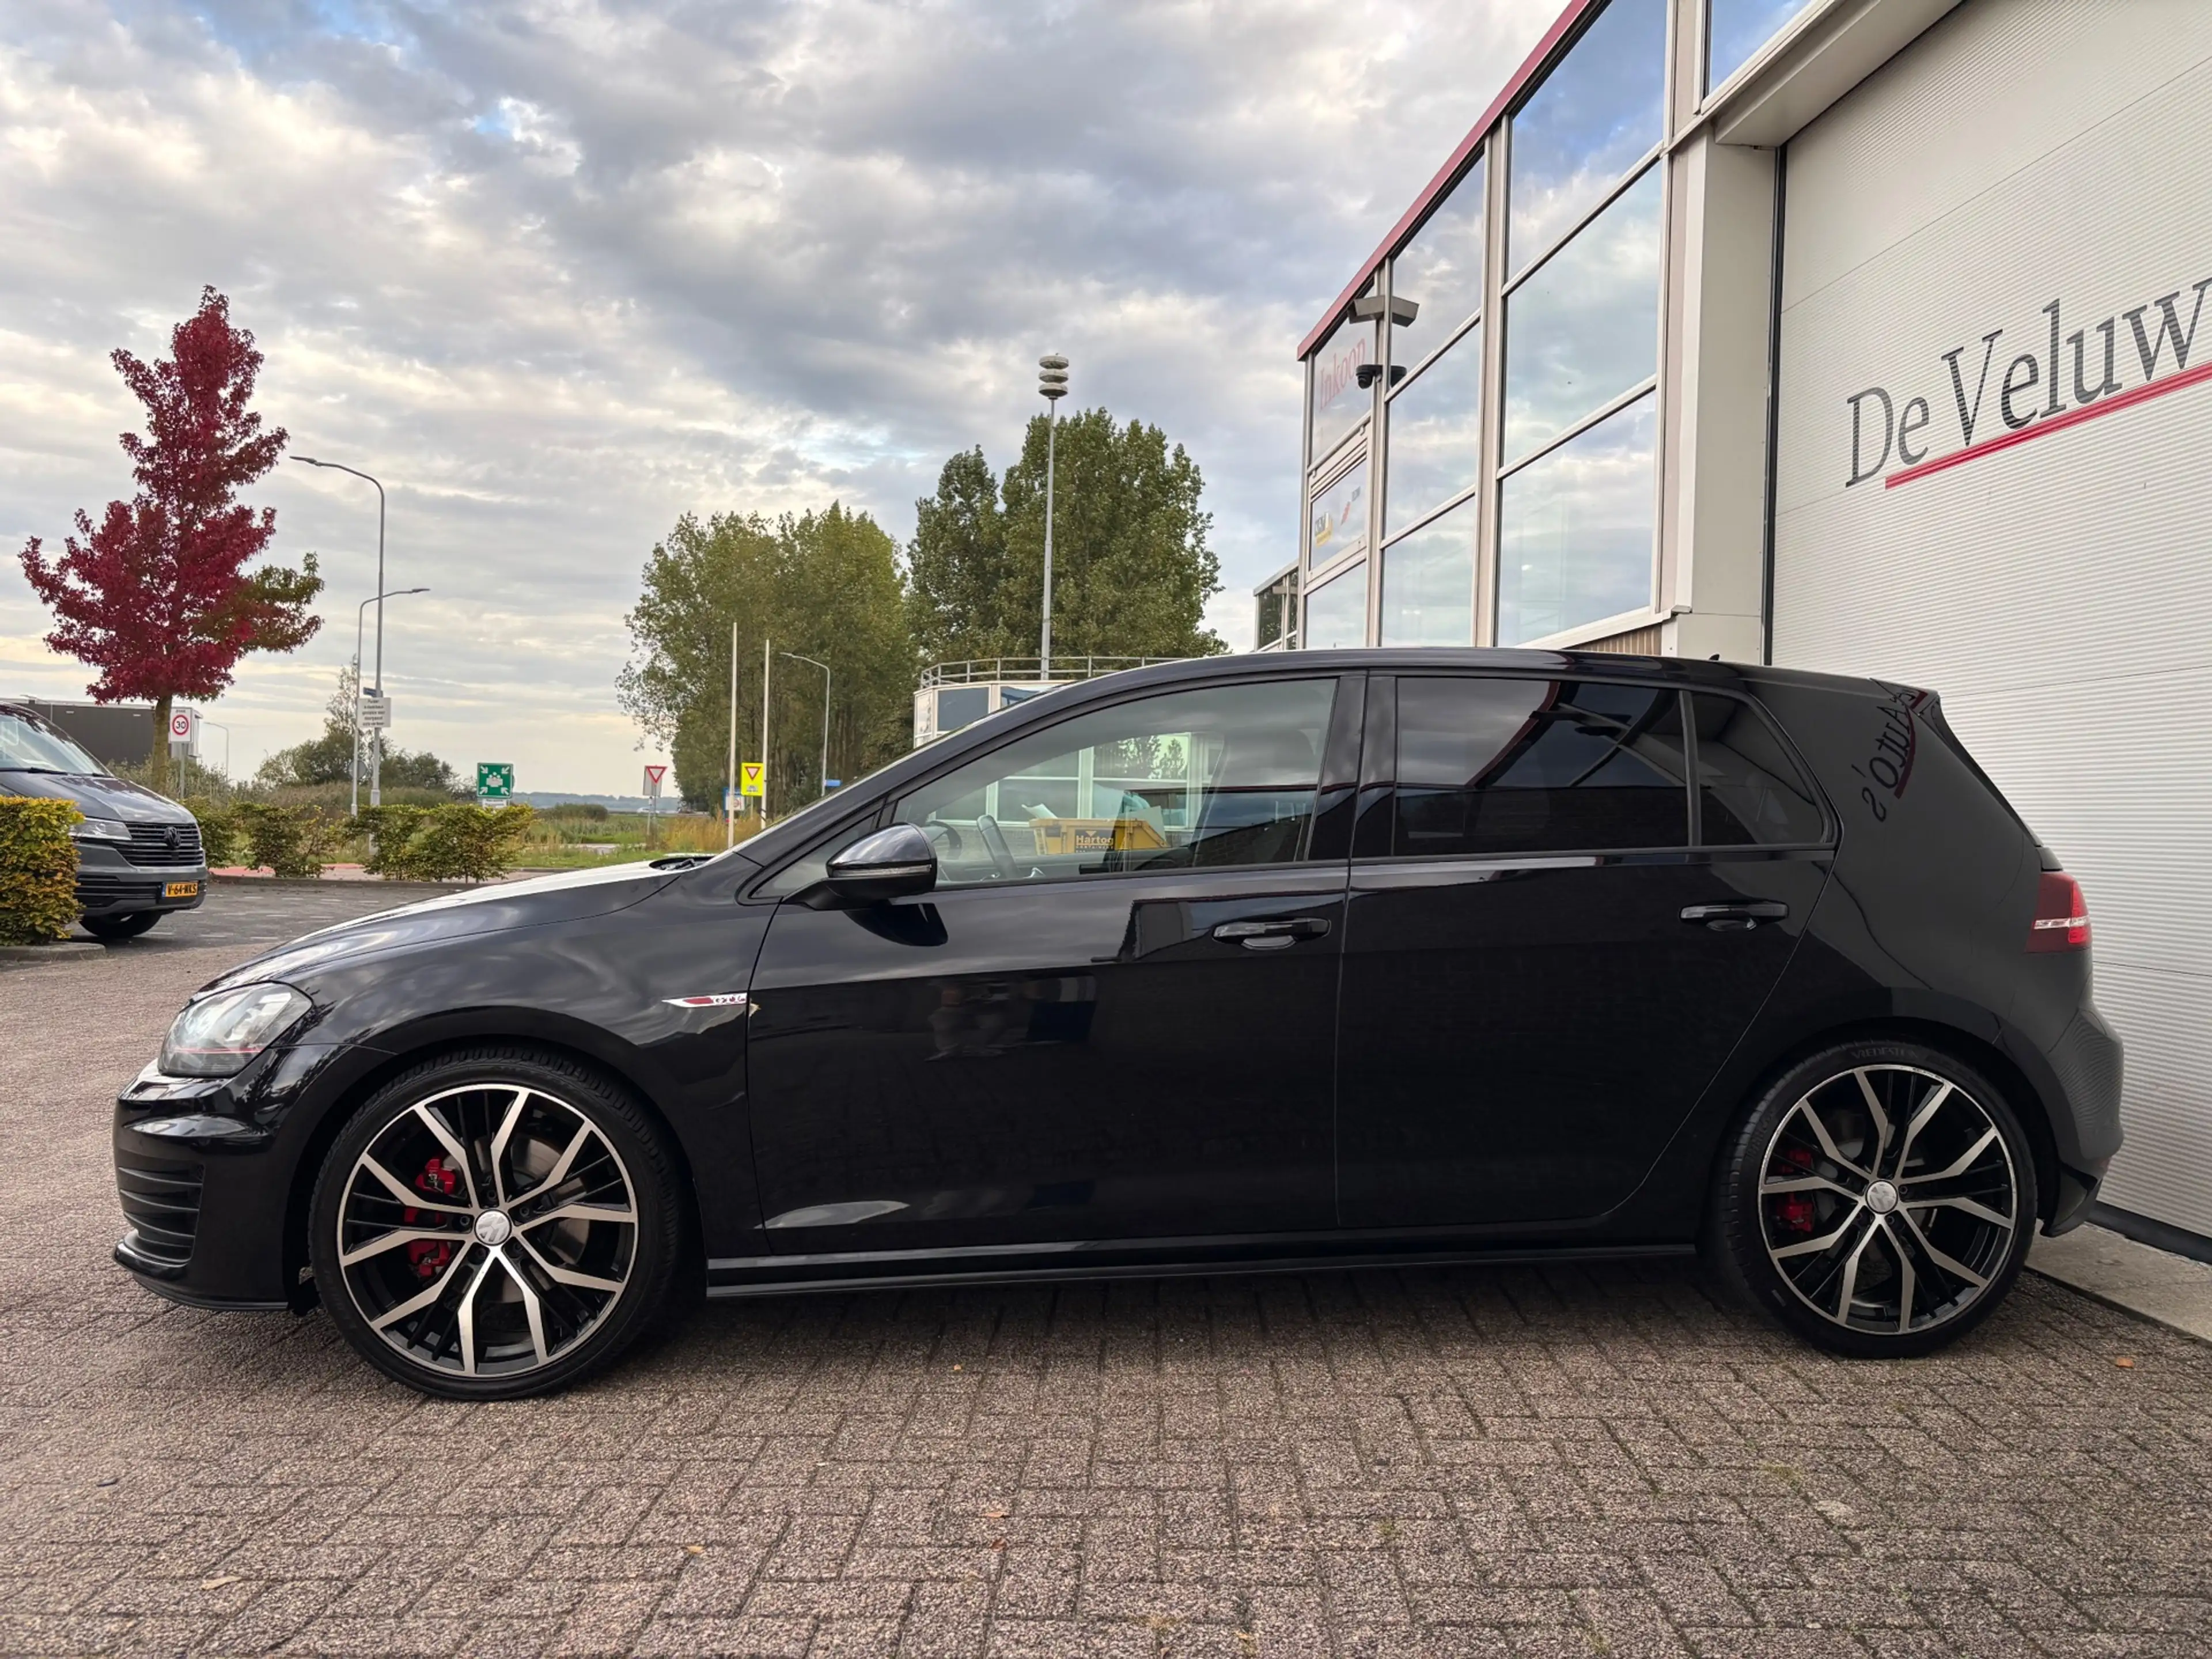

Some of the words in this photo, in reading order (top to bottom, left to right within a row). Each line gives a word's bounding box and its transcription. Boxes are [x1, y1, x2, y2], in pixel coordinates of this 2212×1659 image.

[1845, 387, 1930, 488] De
[1941, 276, 2212, 447] Veluw
[176, 721, 186, 729] 30
[1076, 835, 1113, 846] Hartog
